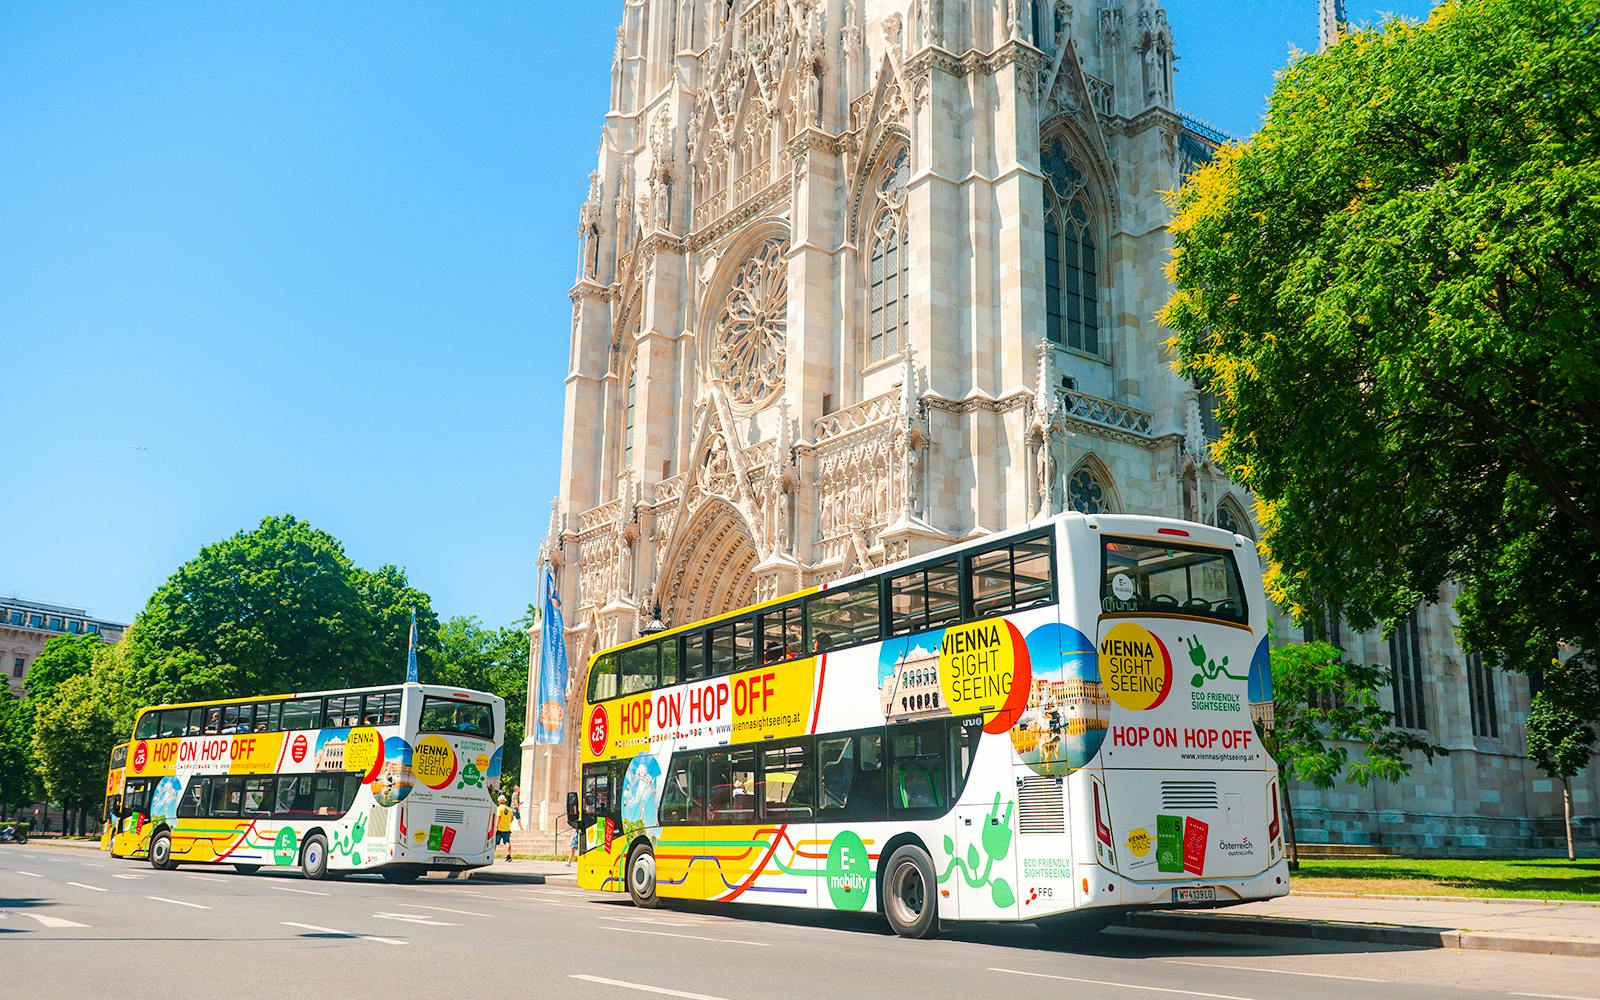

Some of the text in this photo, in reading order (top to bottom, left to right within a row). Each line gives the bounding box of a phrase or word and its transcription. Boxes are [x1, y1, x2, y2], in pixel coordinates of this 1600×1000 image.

[942, 625, 1001, 656] VIENNA
[1101, 640, 1154, 658] VIENNA
[951, 650, 998, 678] SIGHT
[1109, 658, 1152, 675] SIGHT
[952, 672, 1012, 702] SEEING
[1110, 675, 1164, 693] SEEING
[620, 673, 775, 735] HOP ON HOP OFF
[1191, 691, 1240, 701] ECO FRIENDLY
[1191, 701, 1241, 712] SIGHTSEEING
[716, 712, 801, 734] www.viennasightseeing.at
[347, 733, 374, 744] VIENNA
[1113, 726, 1252, 749] HOP ON HOP OFF
[153, 738, 257, 762] HOP ON HOP OFF
[415, 744, 449, 757] VIENNA
[1181, 753, 1254, 762] www.viennasightseeing.at
[419, 755, 447, 766] SIGHT
[418, 765, 452, 777] SEEING
[1219, 839, 1253, 850] Österreich
[840, 847, 856, 870] E-
[1023, 858, 1070, 868] ECO FRIENDLY
[1024, 868, 1071, 878] SIGHTSEEING
[831, 872, 867, 893] mobility
[1038, 887, 1053, 897] FFG
